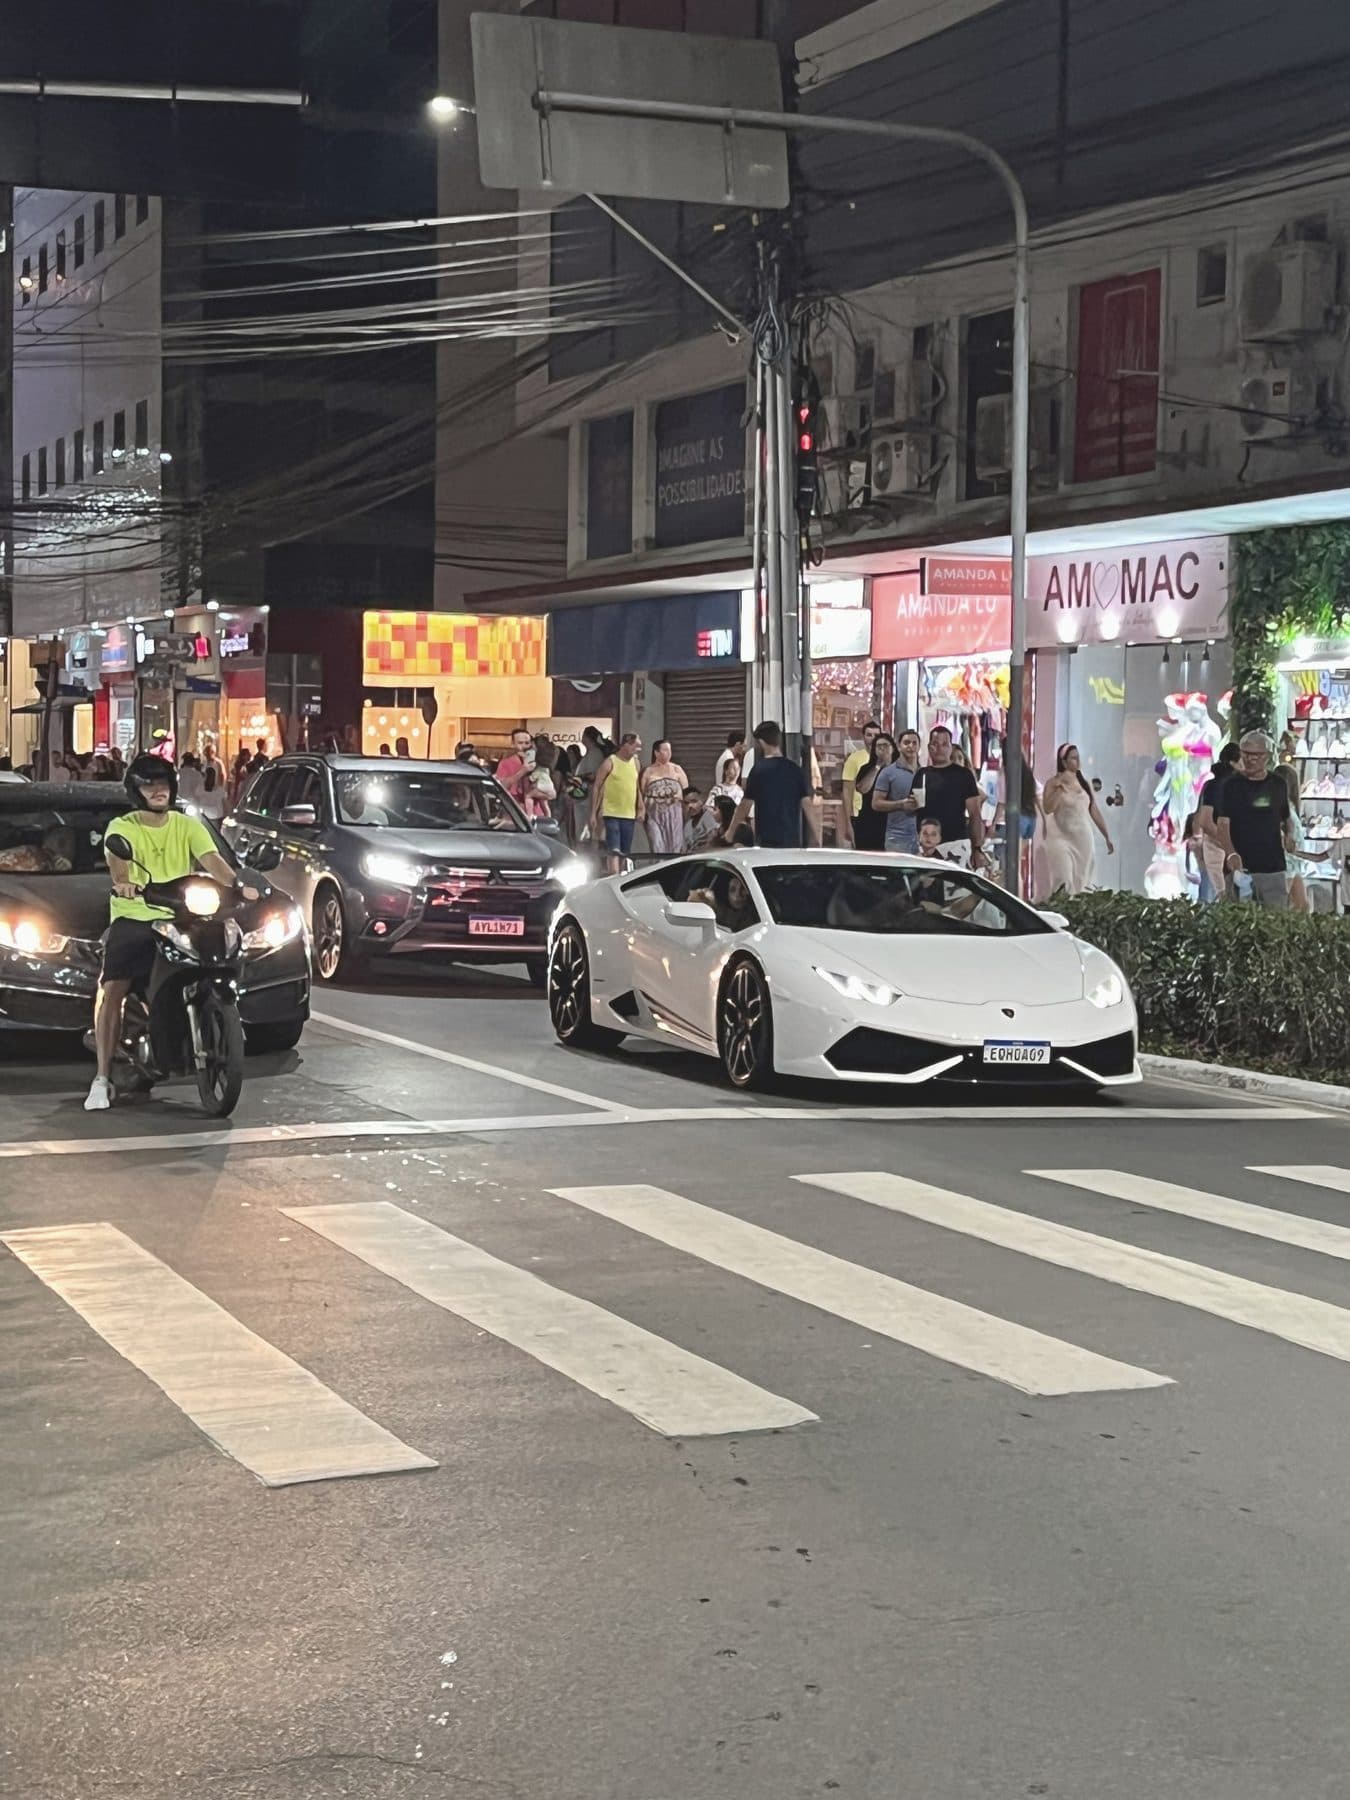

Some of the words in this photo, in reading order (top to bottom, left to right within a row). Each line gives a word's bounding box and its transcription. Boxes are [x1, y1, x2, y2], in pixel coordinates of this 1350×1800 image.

[709, 436, 723, 462] AS
[934, 567, 997, 581] AMANDA
[896, 592, 970, 620] AMANDA
